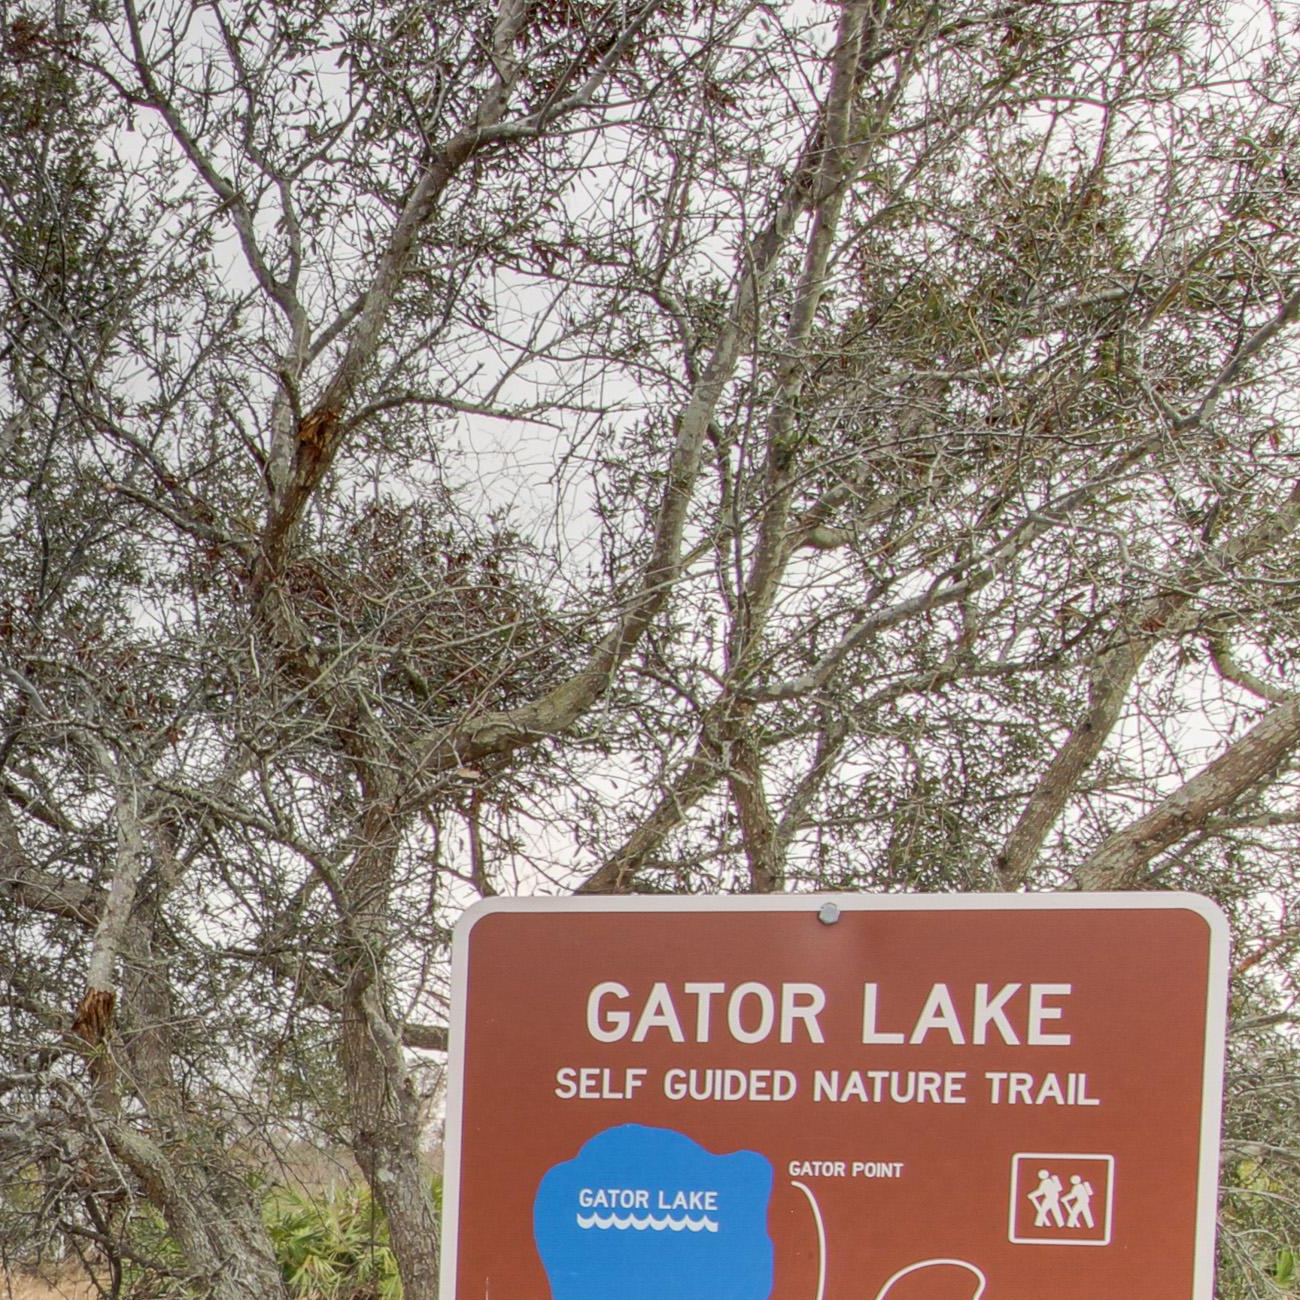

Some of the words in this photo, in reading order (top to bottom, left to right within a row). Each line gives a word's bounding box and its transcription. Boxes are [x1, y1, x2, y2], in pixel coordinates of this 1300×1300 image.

[586, 981, 826, 1044] GATOR
[862, 982, 1072, 1046] LAKE
[555, 1067, 648, 1100] SELF
[664, 1068, 797, 1102] GUIDED
[813, 1070, 967, 1104] NATURE
[985, 1072, 1100, 1106] TRAIL
[788, 1160, 846, 1177] GATOR
[852, 1162, 904, 1179] POINT
[578, 1188, 650, 1209] GATOR
[657, 1190, 719, 1211] LAKE
